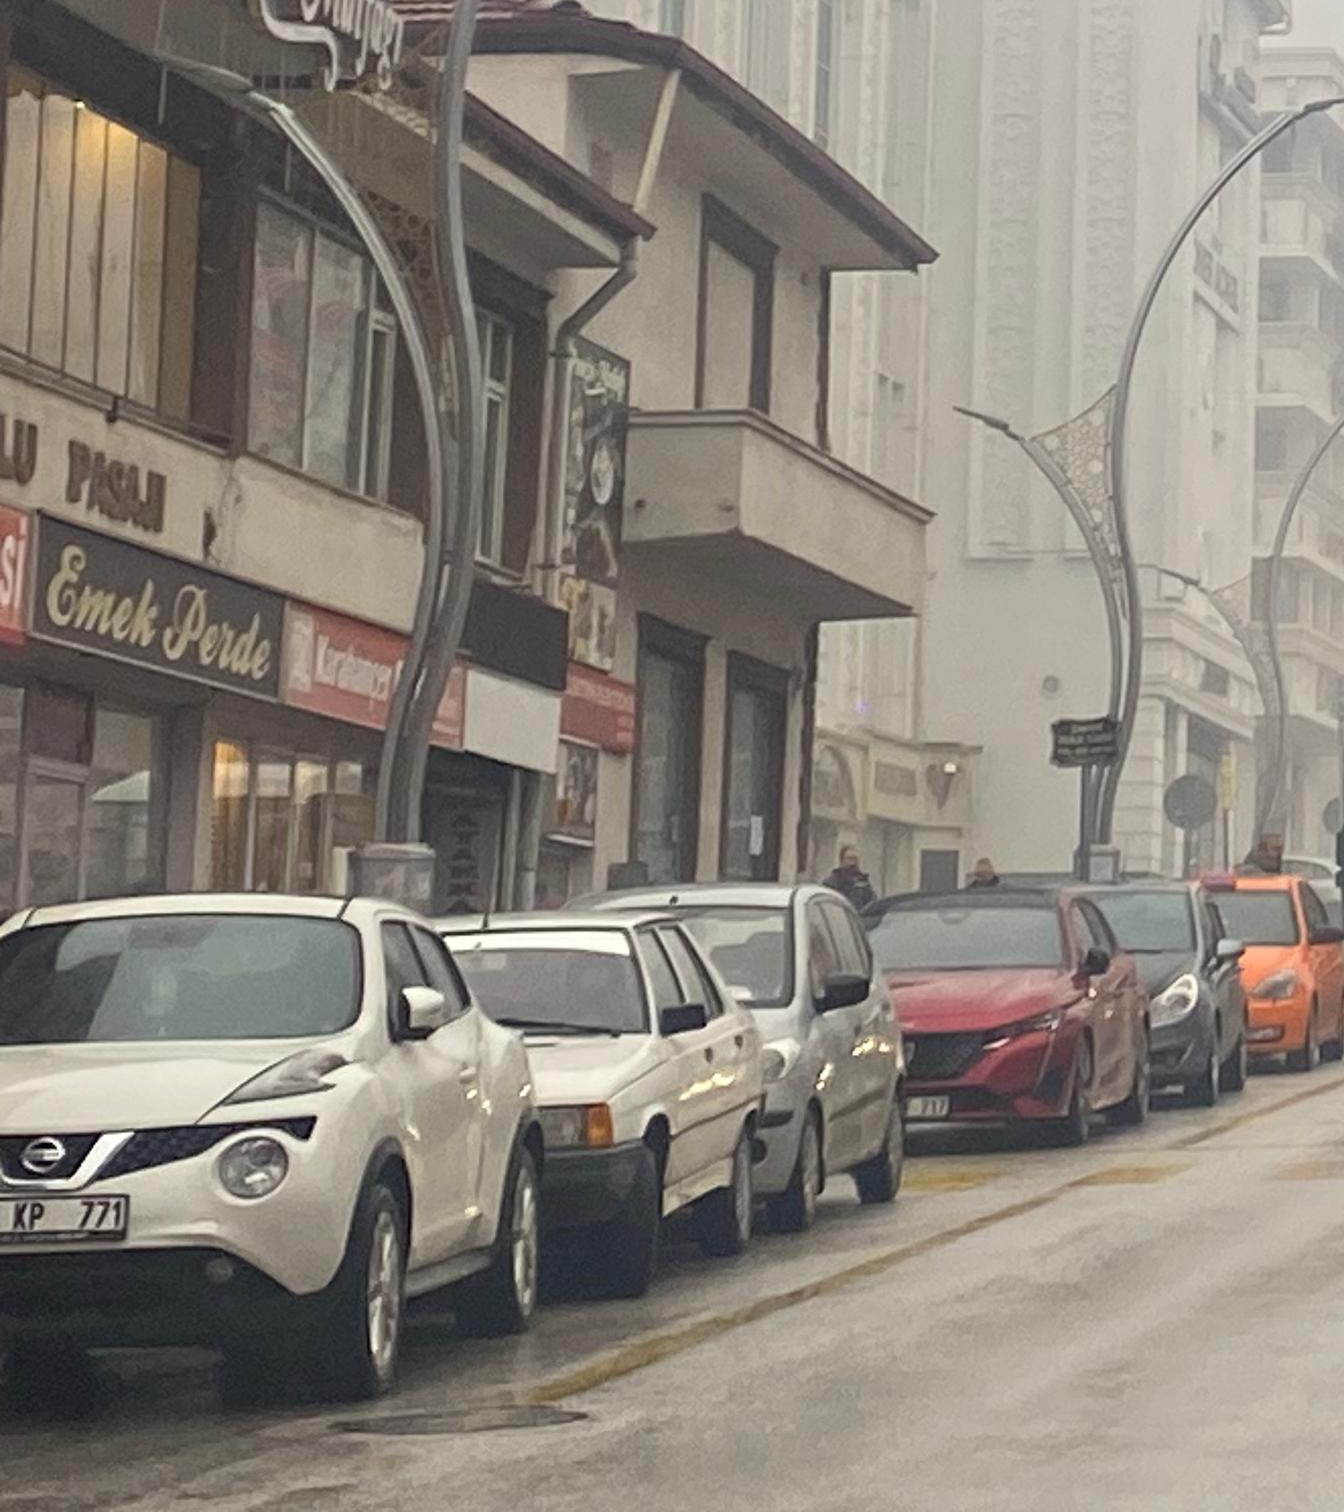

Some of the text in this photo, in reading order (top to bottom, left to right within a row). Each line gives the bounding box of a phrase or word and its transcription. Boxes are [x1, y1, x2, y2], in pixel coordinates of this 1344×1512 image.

[46, 544, 158, 648] Emek
[162, 584, 271, 680] Perde
[13, 1200, 121, 1230] KP 771
